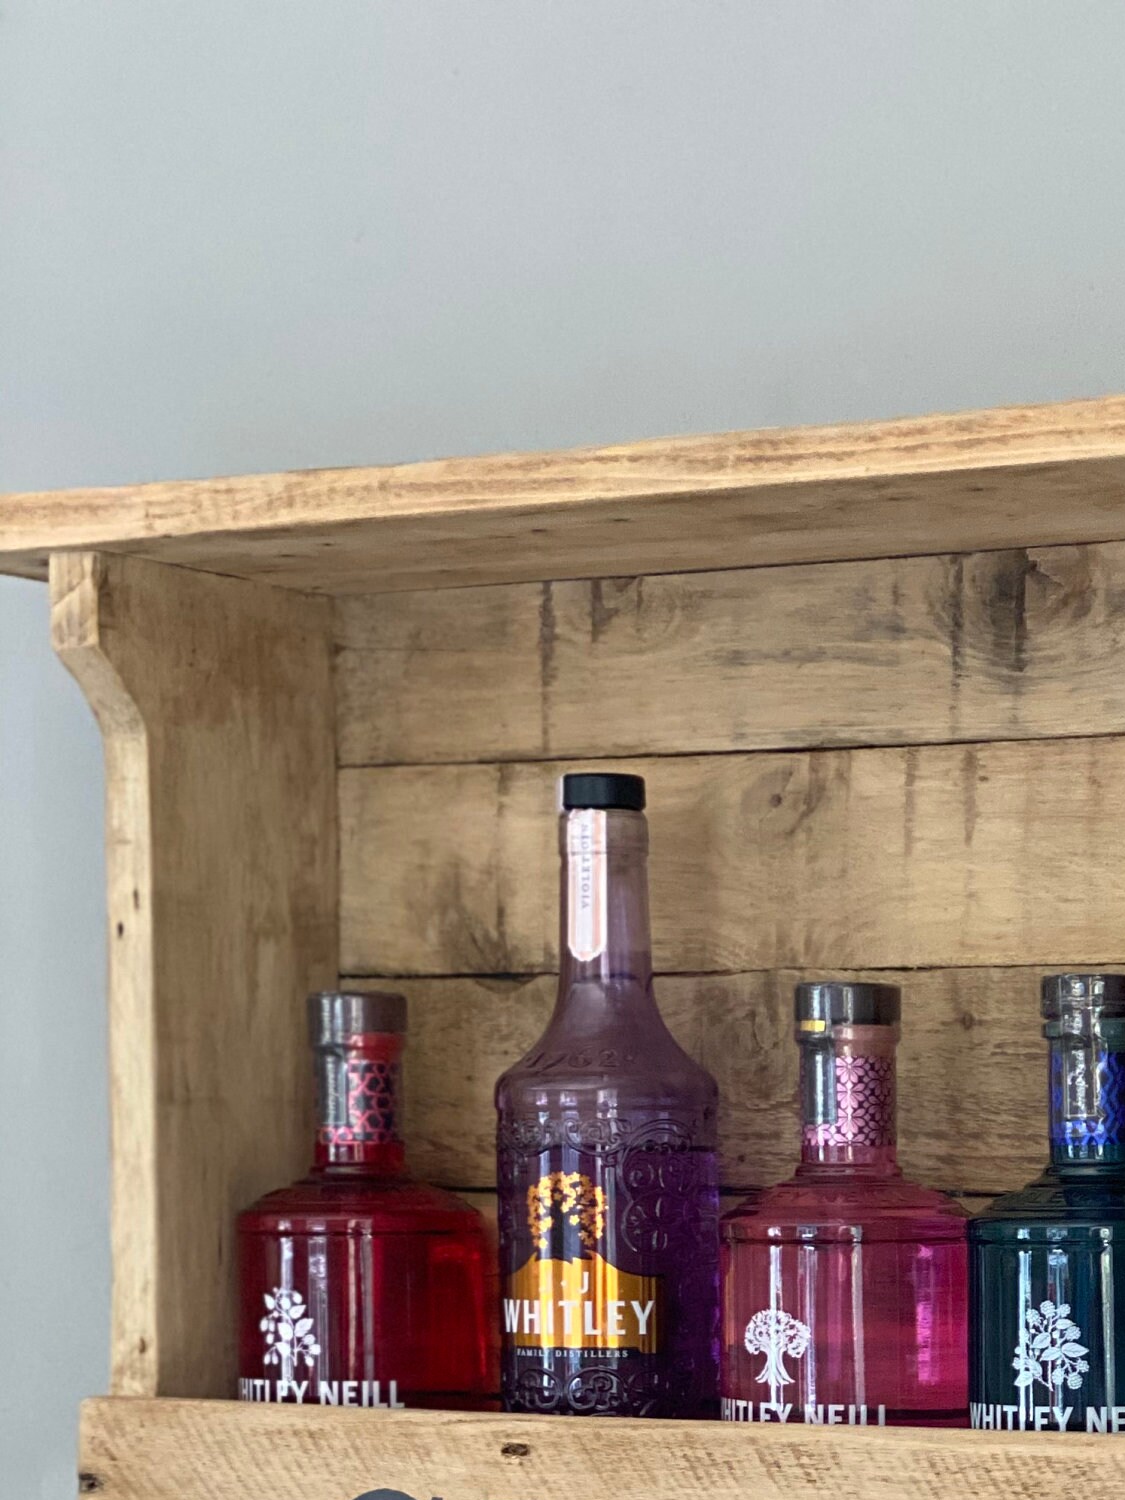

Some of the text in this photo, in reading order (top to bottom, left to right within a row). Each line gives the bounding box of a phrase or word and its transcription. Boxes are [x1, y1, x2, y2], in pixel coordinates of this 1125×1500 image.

[580, 856, 592, 909] VIOLET
[503, 1298, 655, 1335] WHITLEY
[516, 1348, 629, 1358] FAMILY DISTILLERS
[238, 1378, 405, 1408] HITLEY NEILL
[721, 1397, 793, 1424] HITLEY
